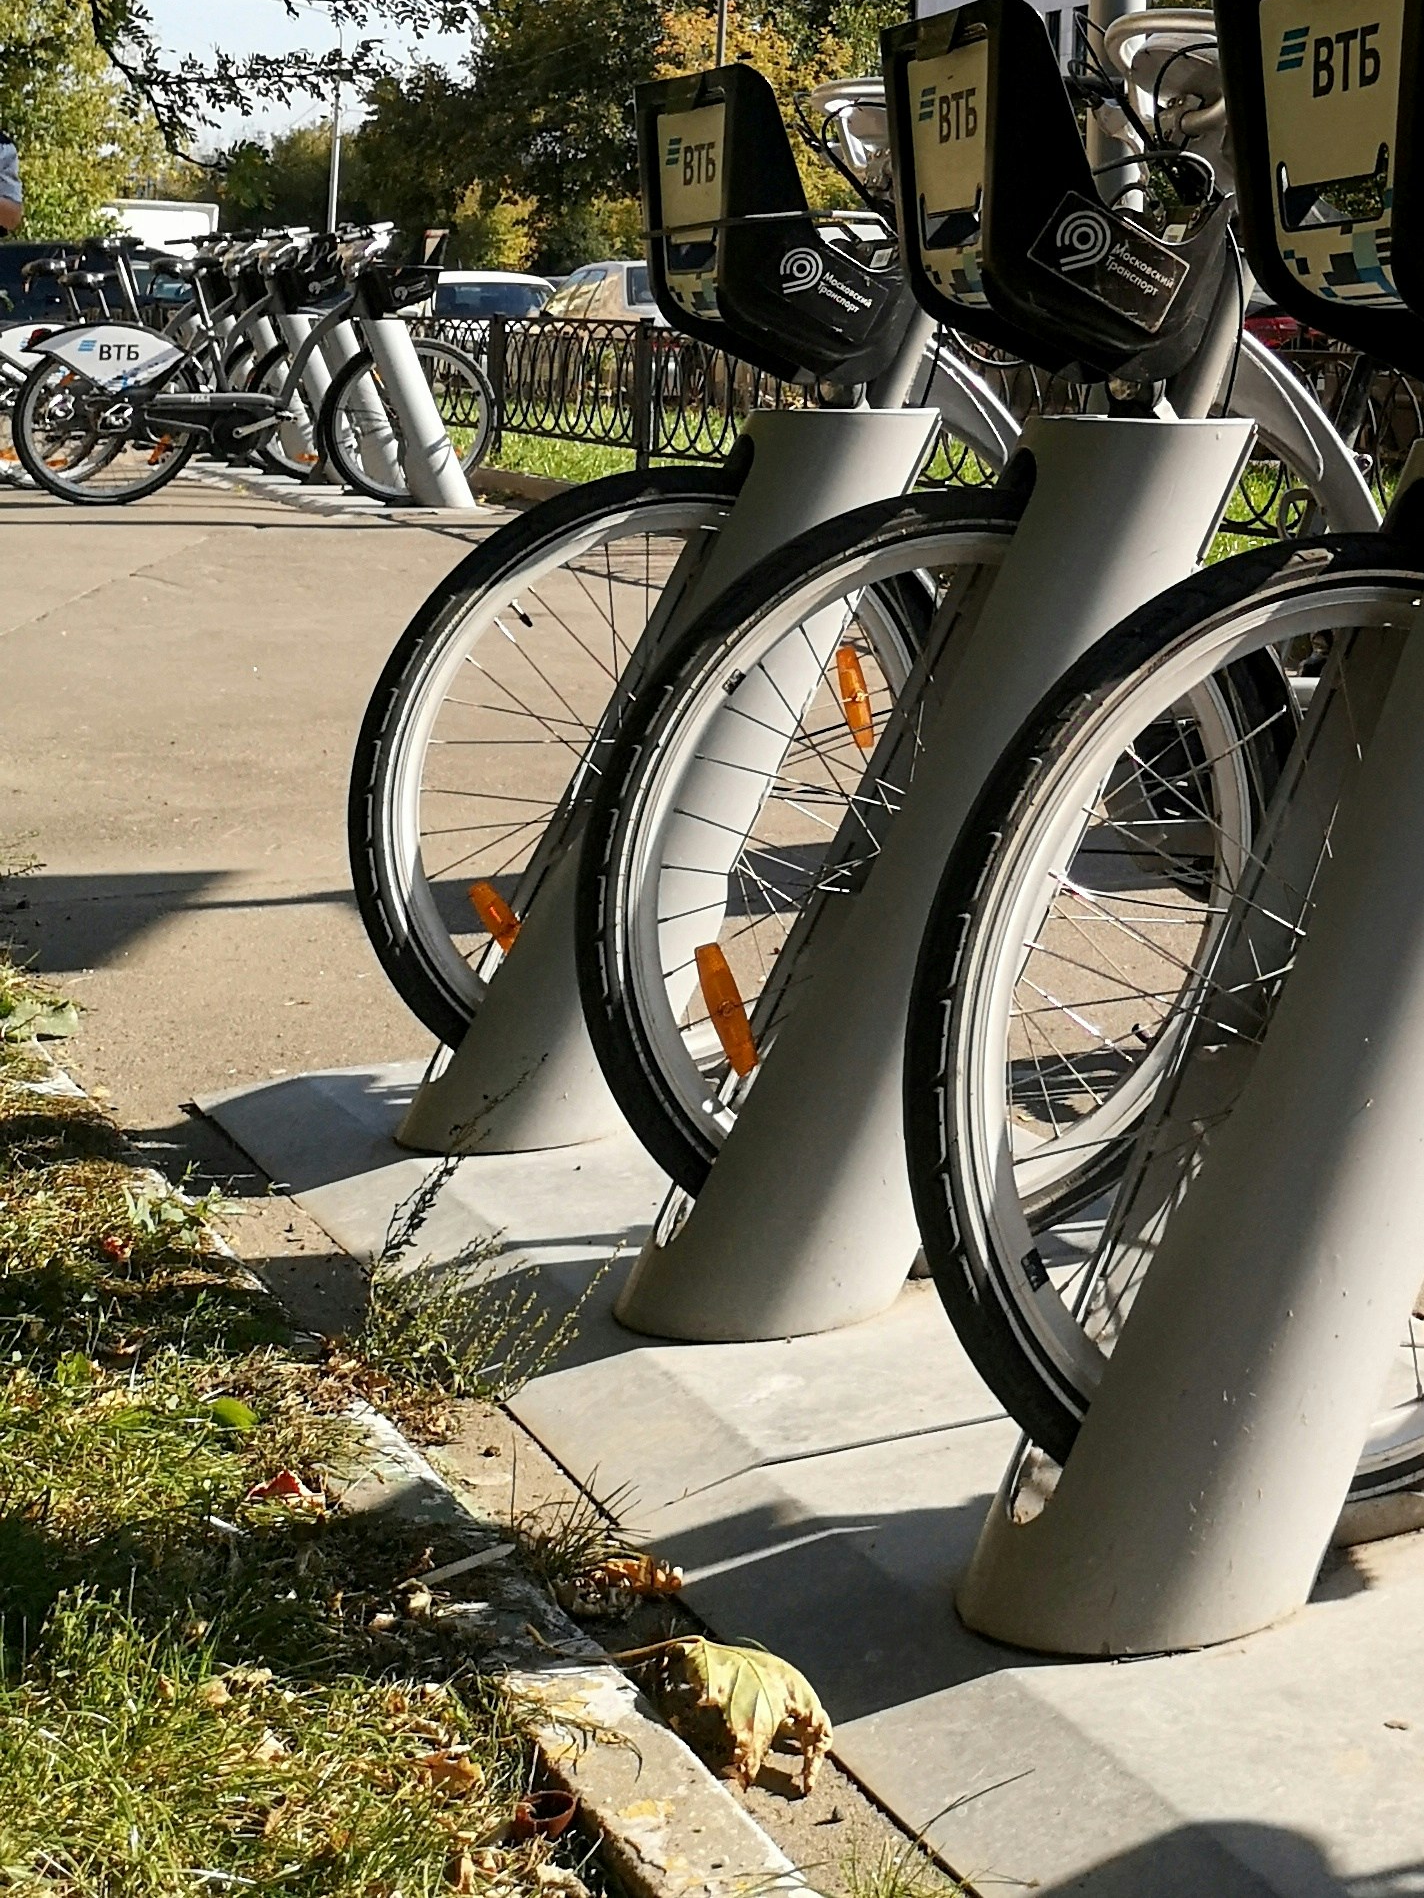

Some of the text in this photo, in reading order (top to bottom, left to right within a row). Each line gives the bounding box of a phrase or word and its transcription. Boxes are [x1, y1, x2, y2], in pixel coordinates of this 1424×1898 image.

[1312, 23, 1381, 98] ВТБ
[938, 87, 978, 144] ВТБ
[683, 141, 716, 185] ВТБ
[1105, 255, 1159, 296] Транспорт
[1109, 242, 1175, 289] Московский
[817, 281, 860, 313] Транспорт
[822, 271, 873, 309] Московский
[99, 343, 140, 361] ВТБ
